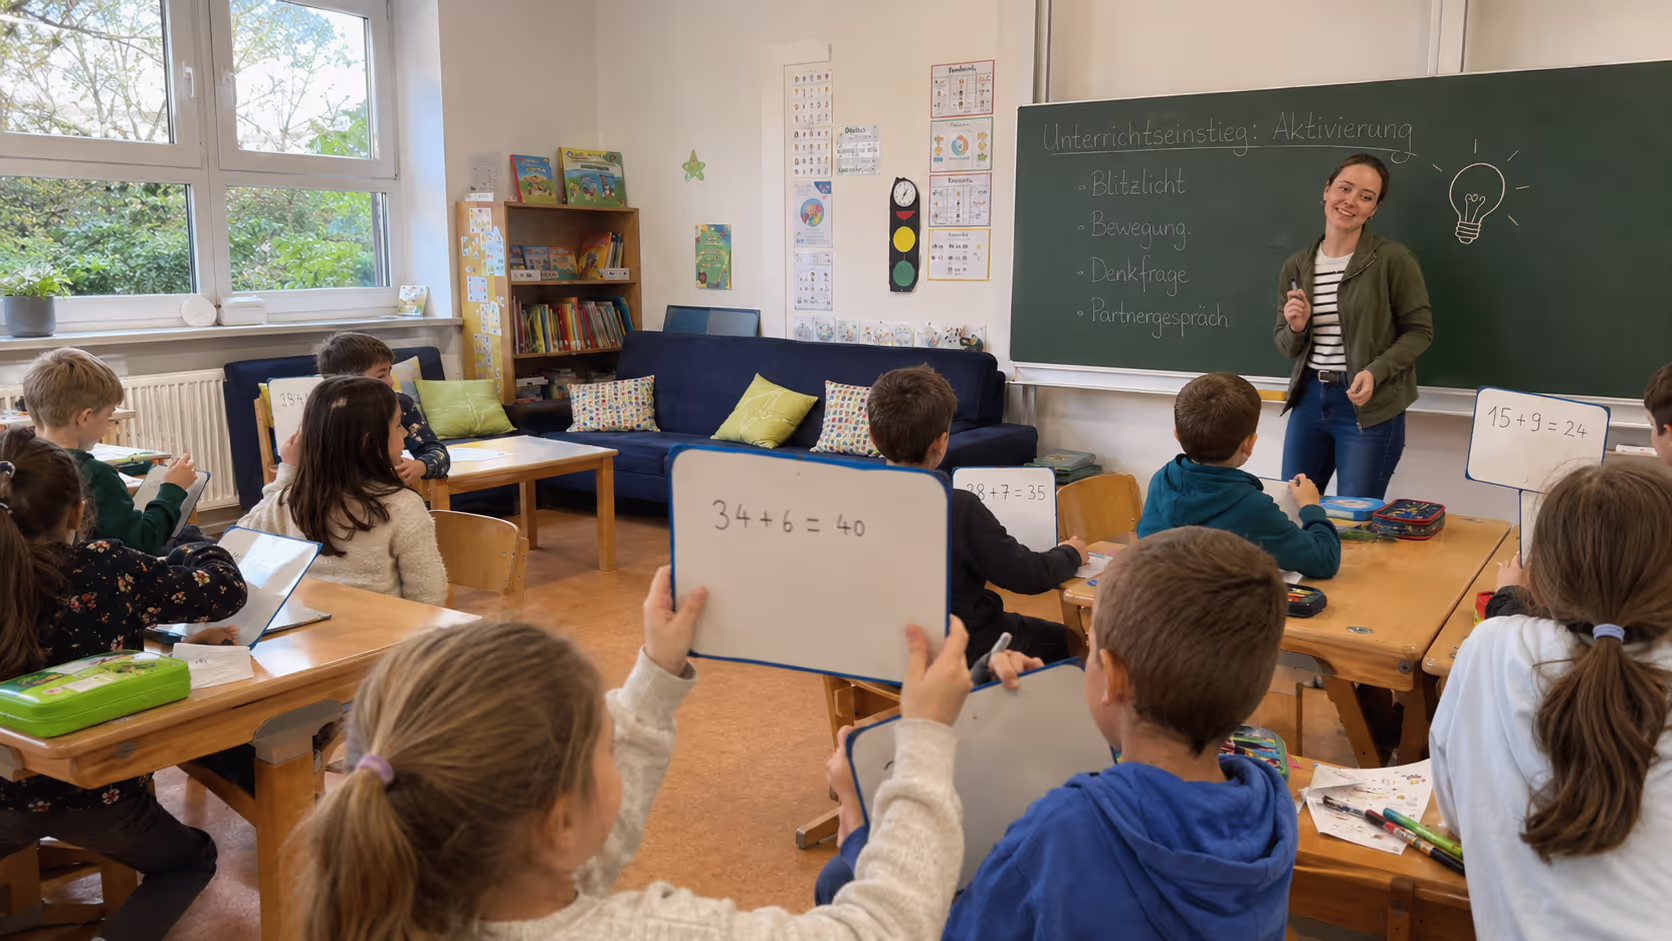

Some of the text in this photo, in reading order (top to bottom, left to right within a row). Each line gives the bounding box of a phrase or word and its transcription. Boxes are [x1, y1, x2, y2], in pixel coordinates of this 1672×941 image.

[1043, 111, 1413, 164] Unterrichtseinstieg: Aktivierung
[1091, 167, 1187, 197] Blitzlicht
[1090, 255, 1189, 297] Denkfrage
[1090, 297, 1230, 339] Partnergespräch
[1563, 420, 1588, 439] 24
[1028, 484, 1046, 500] 35
[836, 514, 866, 537] 40
